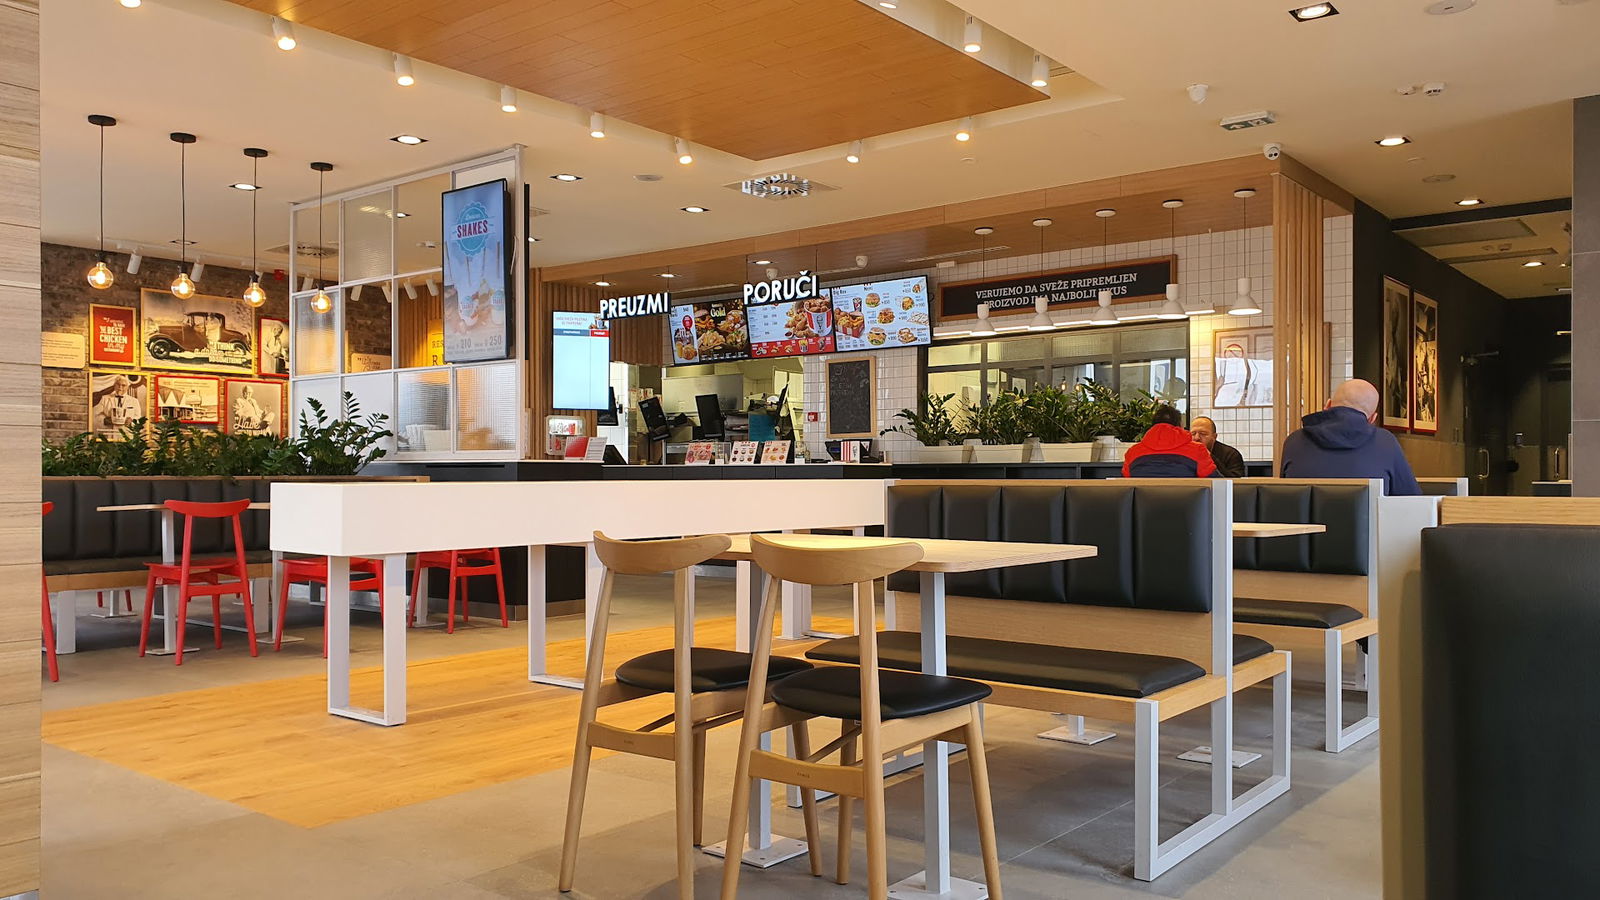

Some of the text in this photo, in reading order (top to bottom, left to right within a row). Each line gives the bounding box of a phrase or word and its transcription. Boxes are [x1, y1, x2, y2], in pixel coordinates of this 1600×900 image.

[457, 219, 488, 239] SHAKES
[743, 270, 817, 305] PORUČI
[976, 273, 1138, 299] VERUJEMO DA SVEŽE PRIPREMLJEN
[1031, 294, 1049, 304] IA
[1052, 289, 1096, 302] NAJBOLJI
[1098, 286, 1127, 297] KUS
[600, 292, 668, 319] PREUZMI
[710, 307, 726, 318] Gold
[99, 334, 128, 344] CHICKEN
[107, 326, 123, 336] BEST
